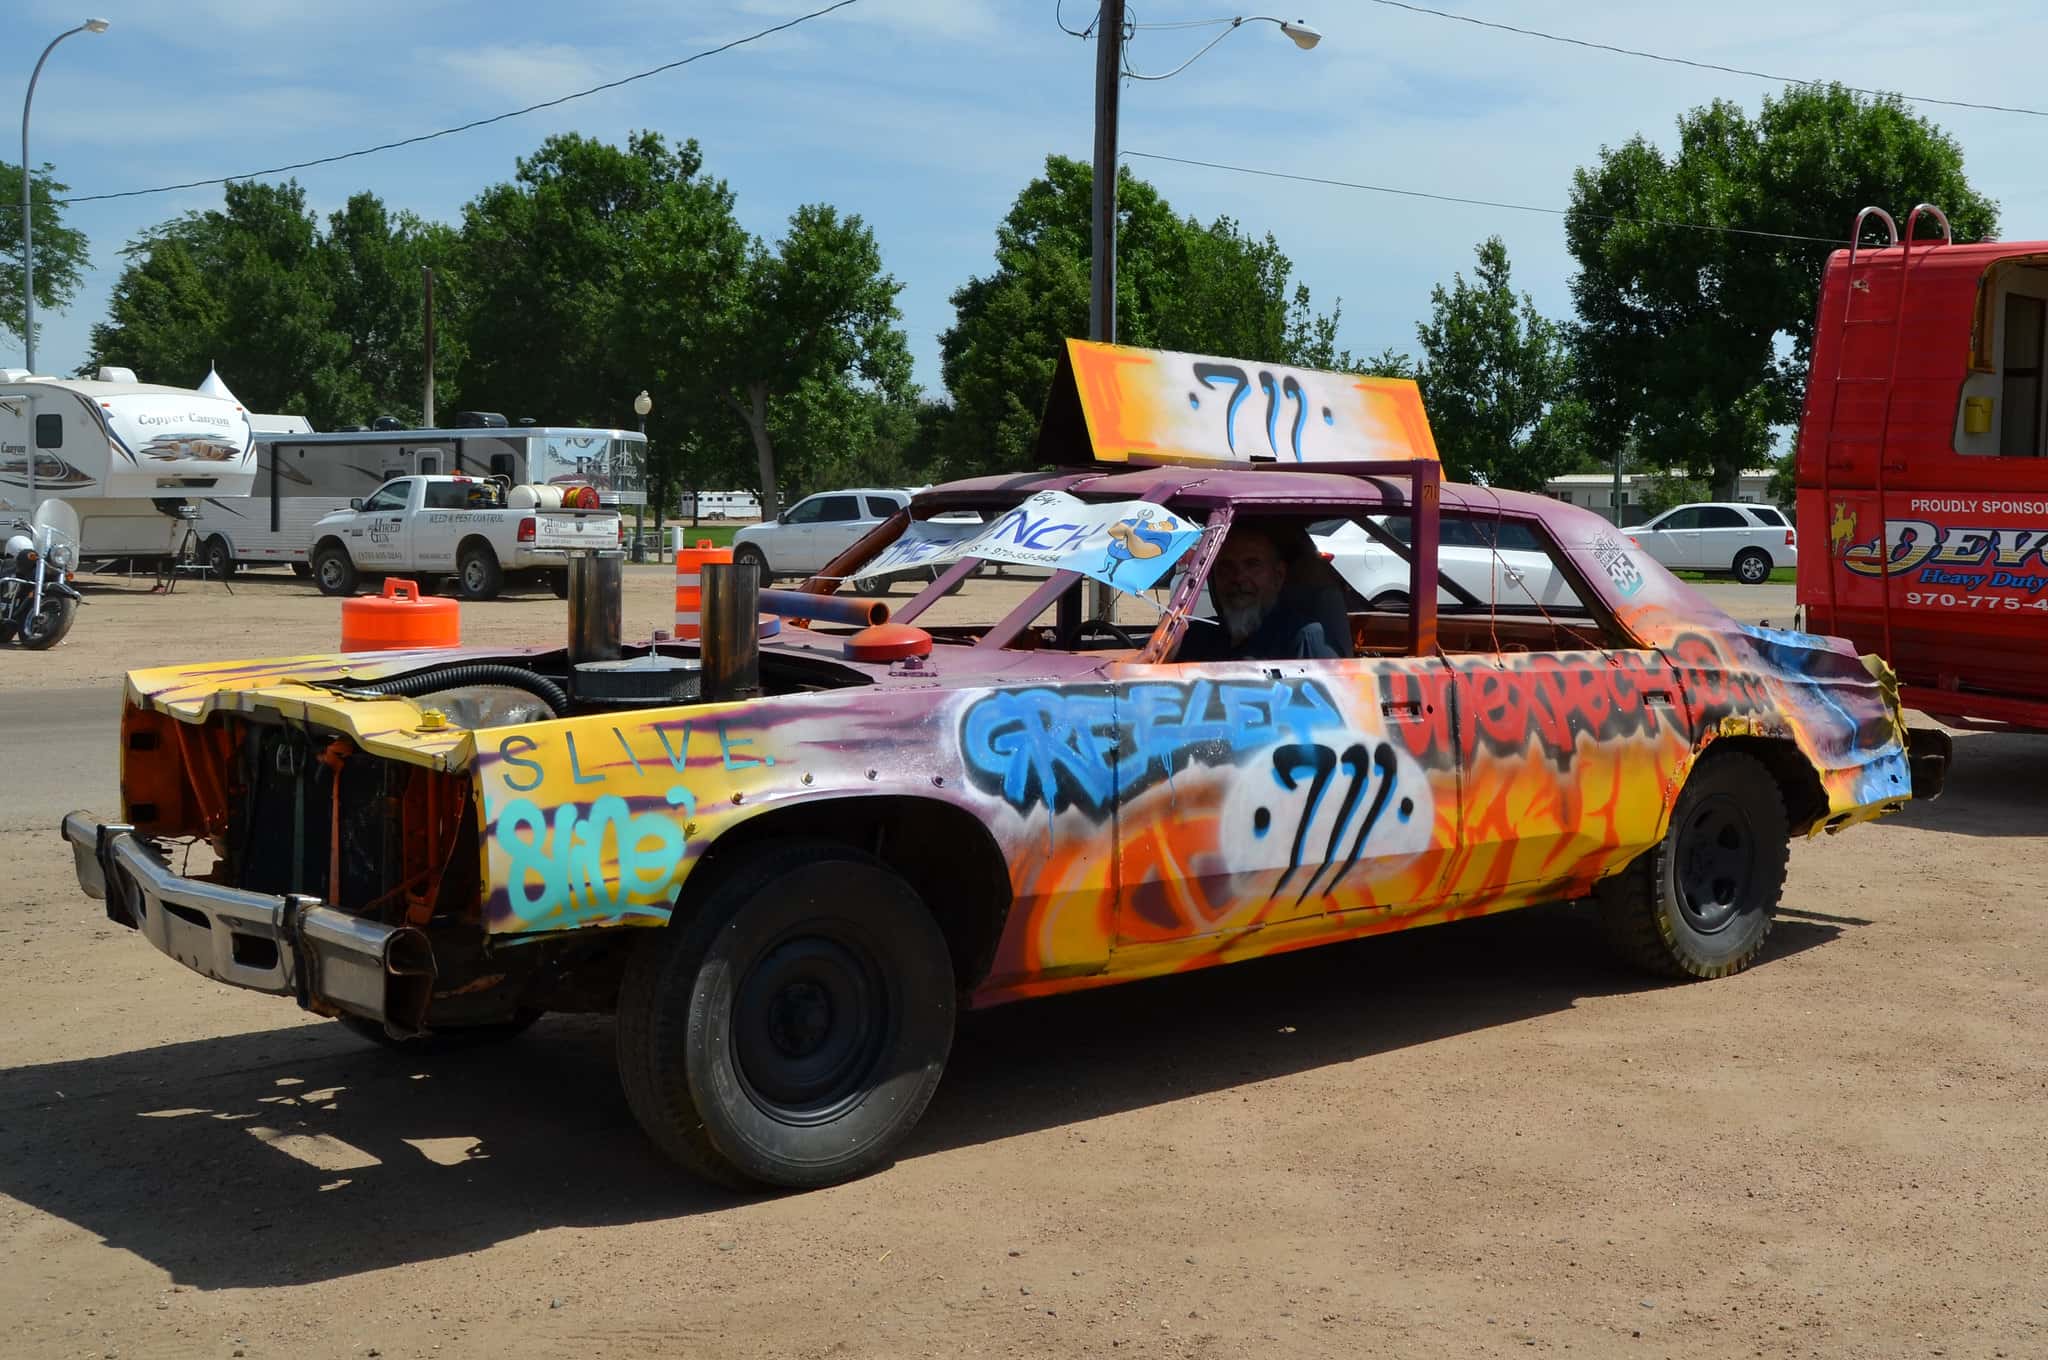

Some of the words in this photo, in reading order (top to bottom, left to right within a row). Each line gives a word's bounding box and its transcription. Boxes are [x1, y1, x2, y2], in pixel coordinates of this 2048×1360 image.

[138, 413, 185, 426] Copper
[188, 411, 230, 428] Canyon
[1911, 500, 1977, 513] PROUDLY
[1919, 568, 1988, 591] Heavy
[1990, 571, 2048, 594] Duty
